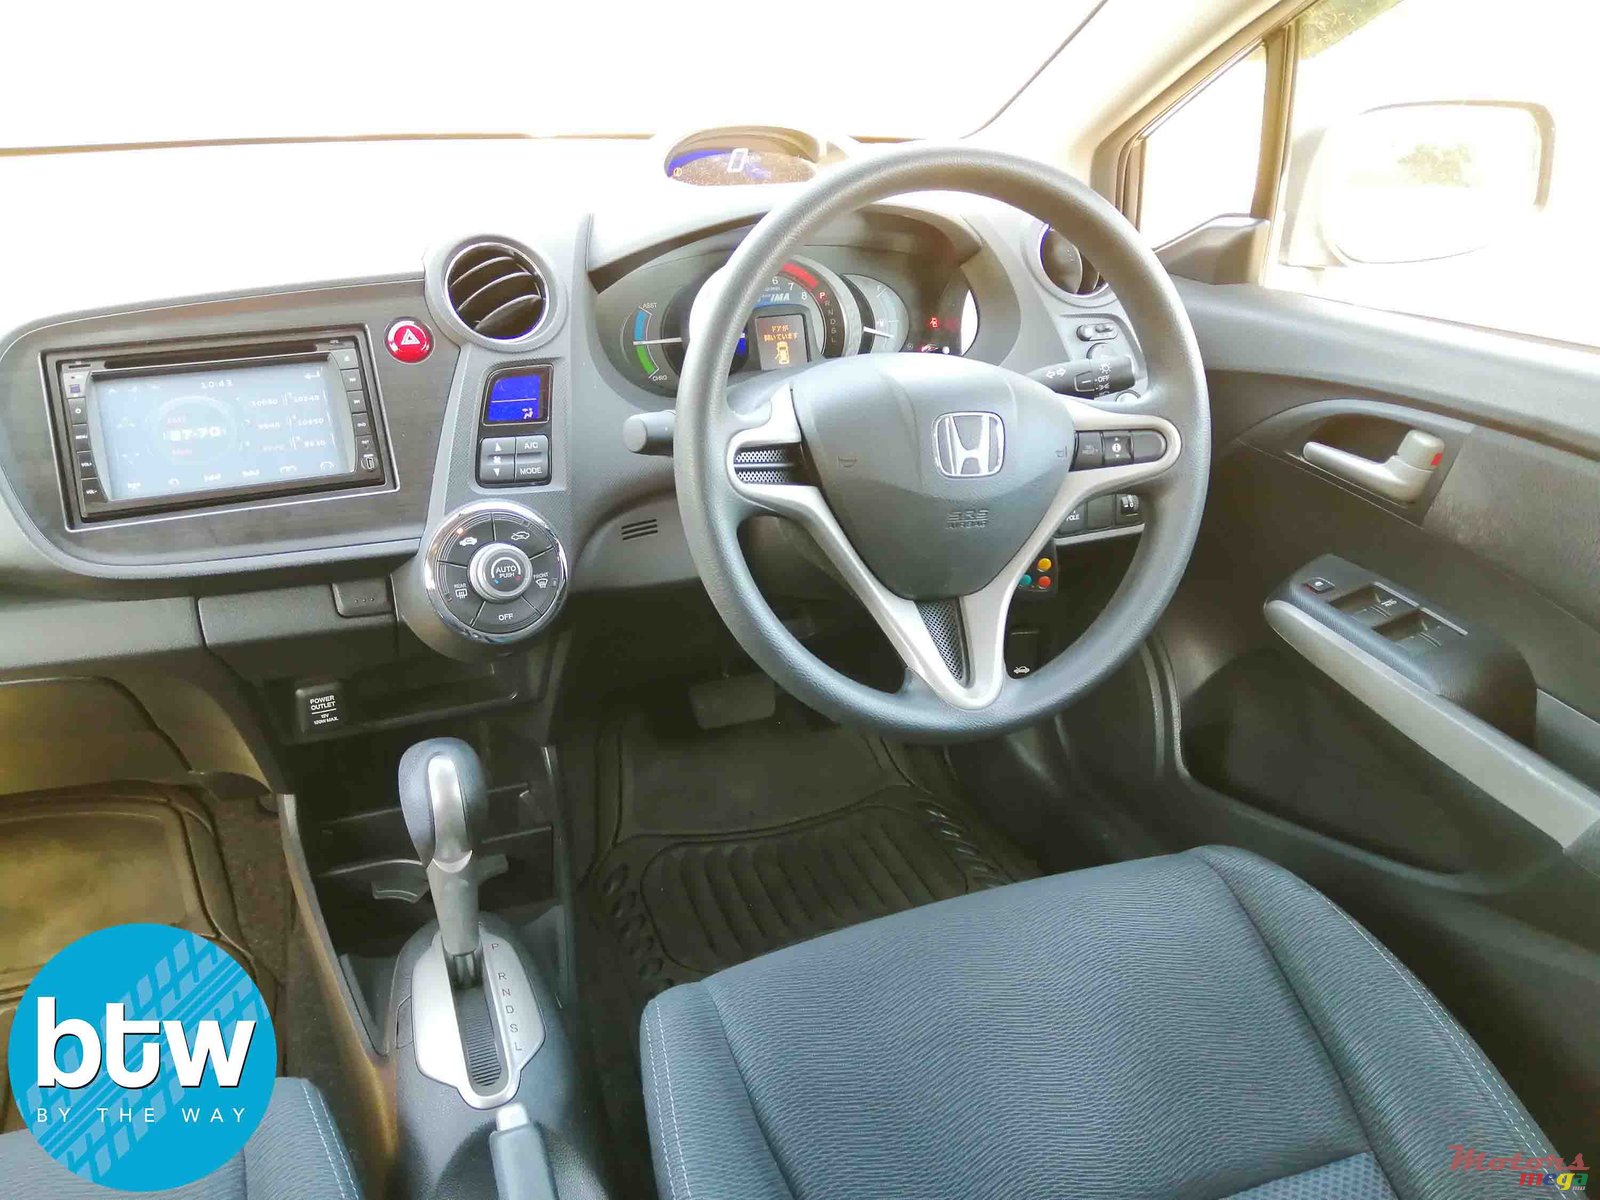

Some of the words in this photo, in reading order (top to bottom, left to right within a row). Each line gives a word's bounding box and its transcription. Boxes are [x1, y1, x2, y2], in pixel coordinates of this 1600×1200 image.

[772, 276, 779, 285] 6
[788, 282, 795, 290] 7
[771, 293, 790, 301] IMA
[801, 291, 808, 300] 8
[819, 291, 826, 299] P
[524, 441, 539, 450] A/C
[519, 467, 542, 475] MODE
[495, 565, 517, 574] AUTO
[498, 612, 514, 622] OFF
[310, 695, 335, 704] POWER
[310, 701, 336, 710] OUTLET
[498, 972, 507, 981] R
[502, 988, 511, 996] N
[506, 1005, 514, 1014] D
[510, 1024, 518, 1033] S
[515, 1042, 522, 1051] L
